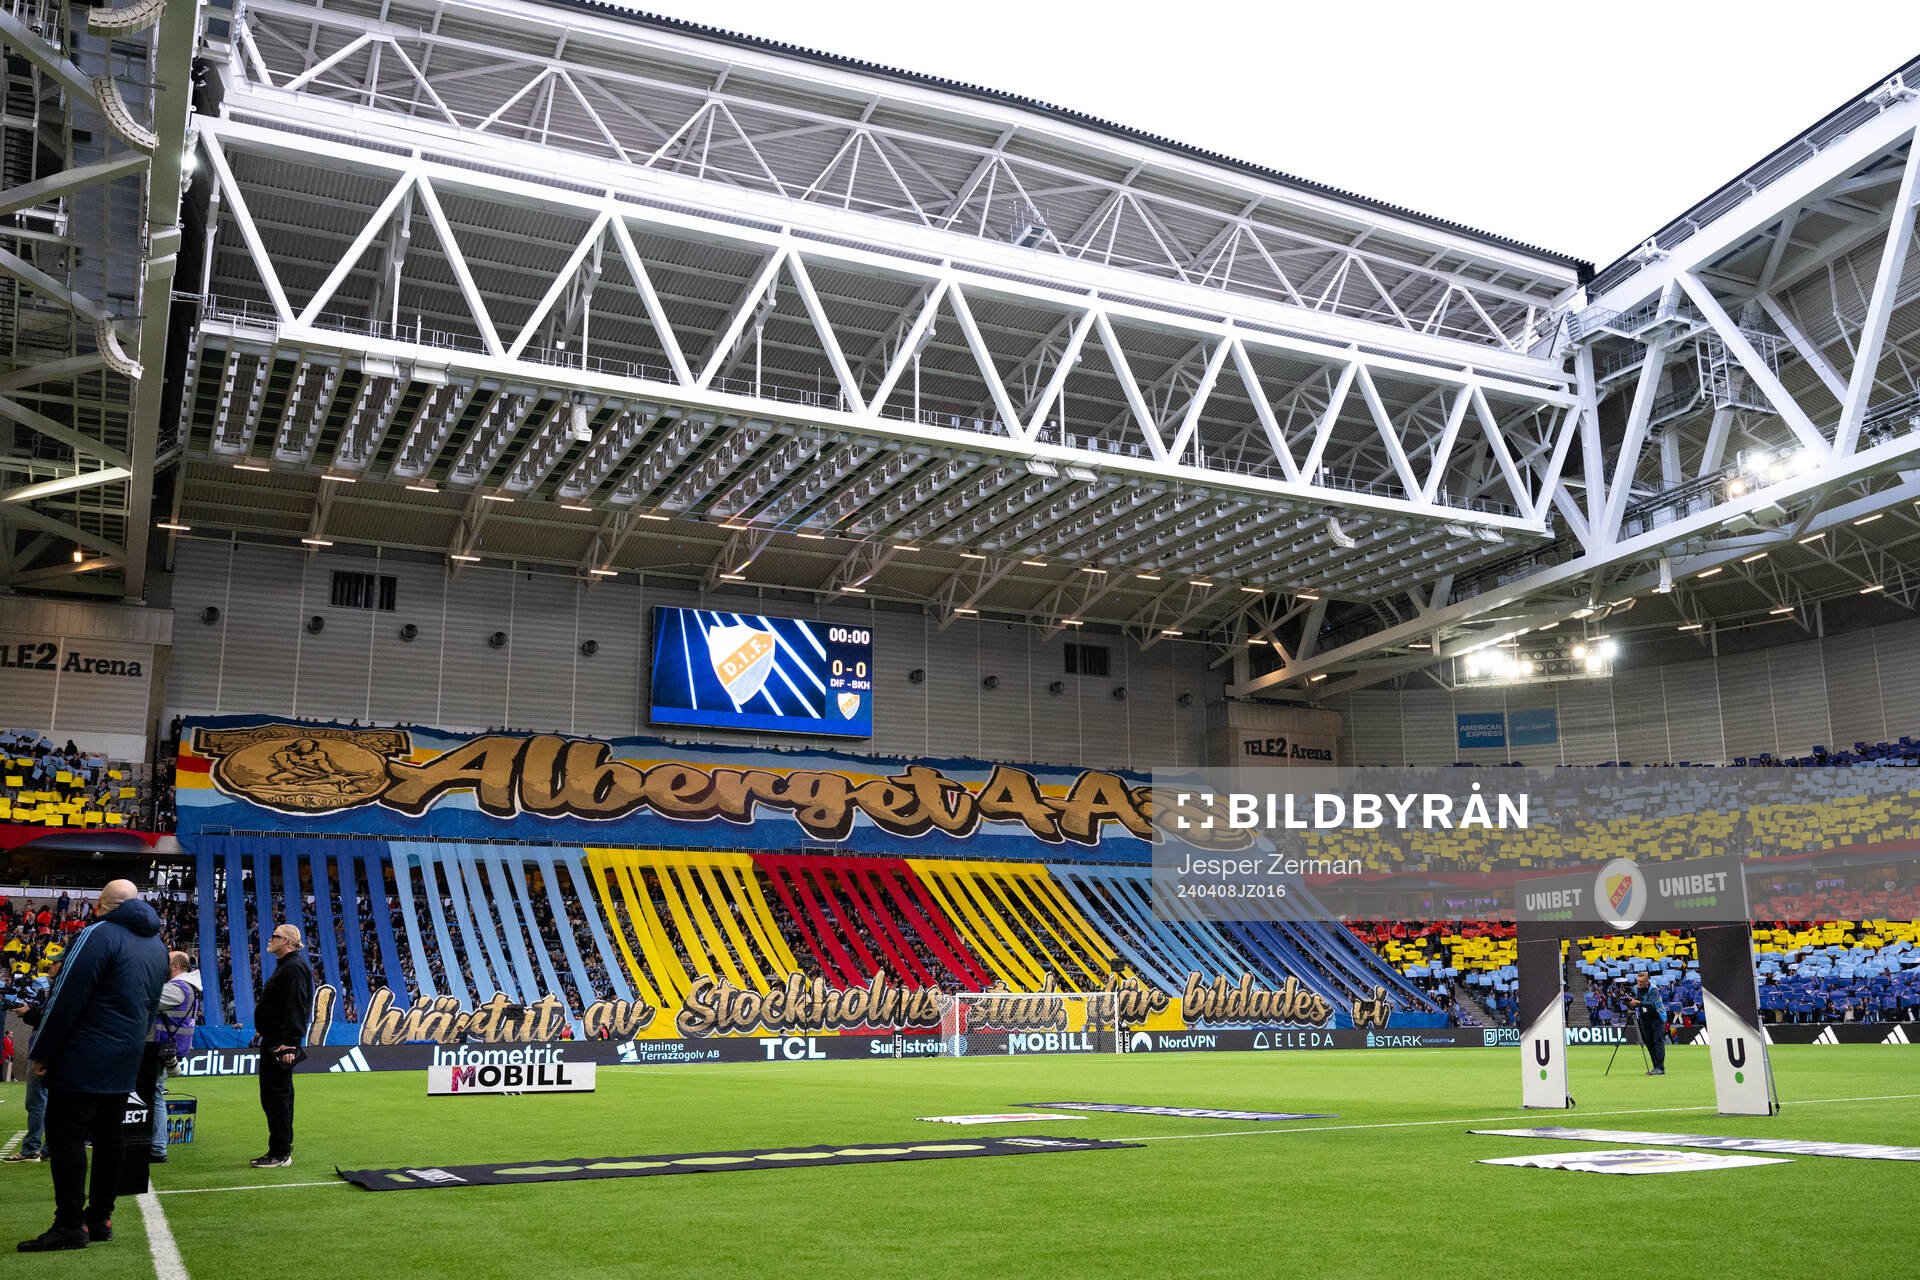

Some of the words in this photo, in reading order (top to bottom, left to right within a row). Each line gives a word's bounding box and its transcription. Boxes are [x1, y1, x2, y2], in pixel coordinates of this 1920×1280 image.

[829, 627, 870, 645] 00:00
[0, 643, 58, 671] LE2
[62, 652, 143, 677] Arena
[830, 678, 846, 688] DIF
[1460, 724, 1502, 732] AMERICAN
[1466, 730, 1503, 738] EXPRESS
[1243, 737, 1288, 758] TELE2
[1290, 744, 1333, 761] Arena
[380, 734, 980, 842] Alberget
[1658, 871, 1728, 898] UNIBET
[1525, 888, 1583, 911] UNIBET
[584, 997, 655, 1042] av
[676, 968, 947, 1038] Stockholms
[1182, 970, 1335, 1028] bildades
[640, 1042, 684, 1053] Haninge
[760, 1036, 827, 1060] TCL
[1008, 1032, 1094, 1055] MOBILL
[1159, 1035, 1217, 1049] NordVPN
[1275, 1032, 1334, 1047] ELEDA
[1375, 1034, 1423, 1047] STARK
[1566, 1027, 1627, 1046] MOBILL
[433, 1043, 565, 1066] Infometric
[641, 1049, 705, 1061] Terrazzogolv
[707, 1050, 720, 1058] AB
[1535, 1039, 1550, 1067] U
[1726, 1037, 1746, 1069] U
[451, 1064, 573, 1092] MOBILL
